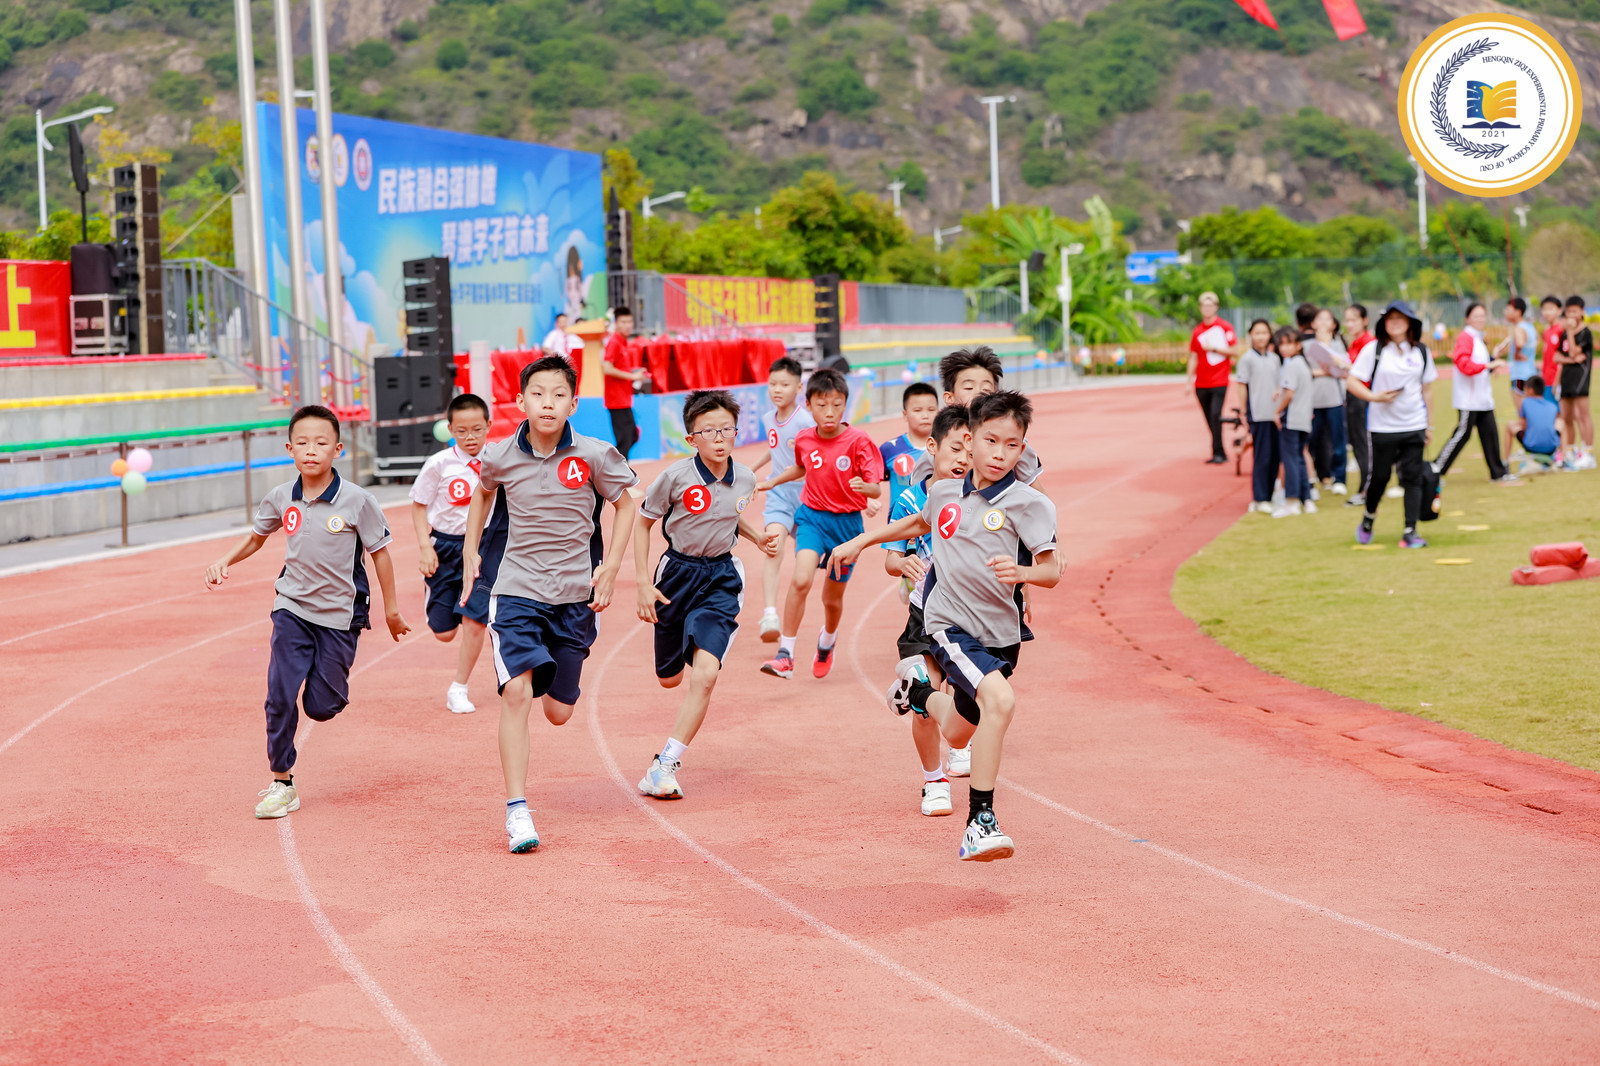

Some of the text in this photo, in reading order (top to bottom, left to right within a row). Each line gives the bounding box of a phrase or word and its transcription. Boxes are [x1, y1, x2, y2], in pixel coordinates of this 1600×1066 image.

[768, 430, 777, 447] 6
[810, 449, 823, 469] 5
[896, 456, 908, 473] 7
[566, 459, 584, 483] 4
[453, 481, 466, 498] 8
[689, 488, 705, 511] 3
[286, 510, 298, 531] 9
[940, 507, 957, 536] 2
